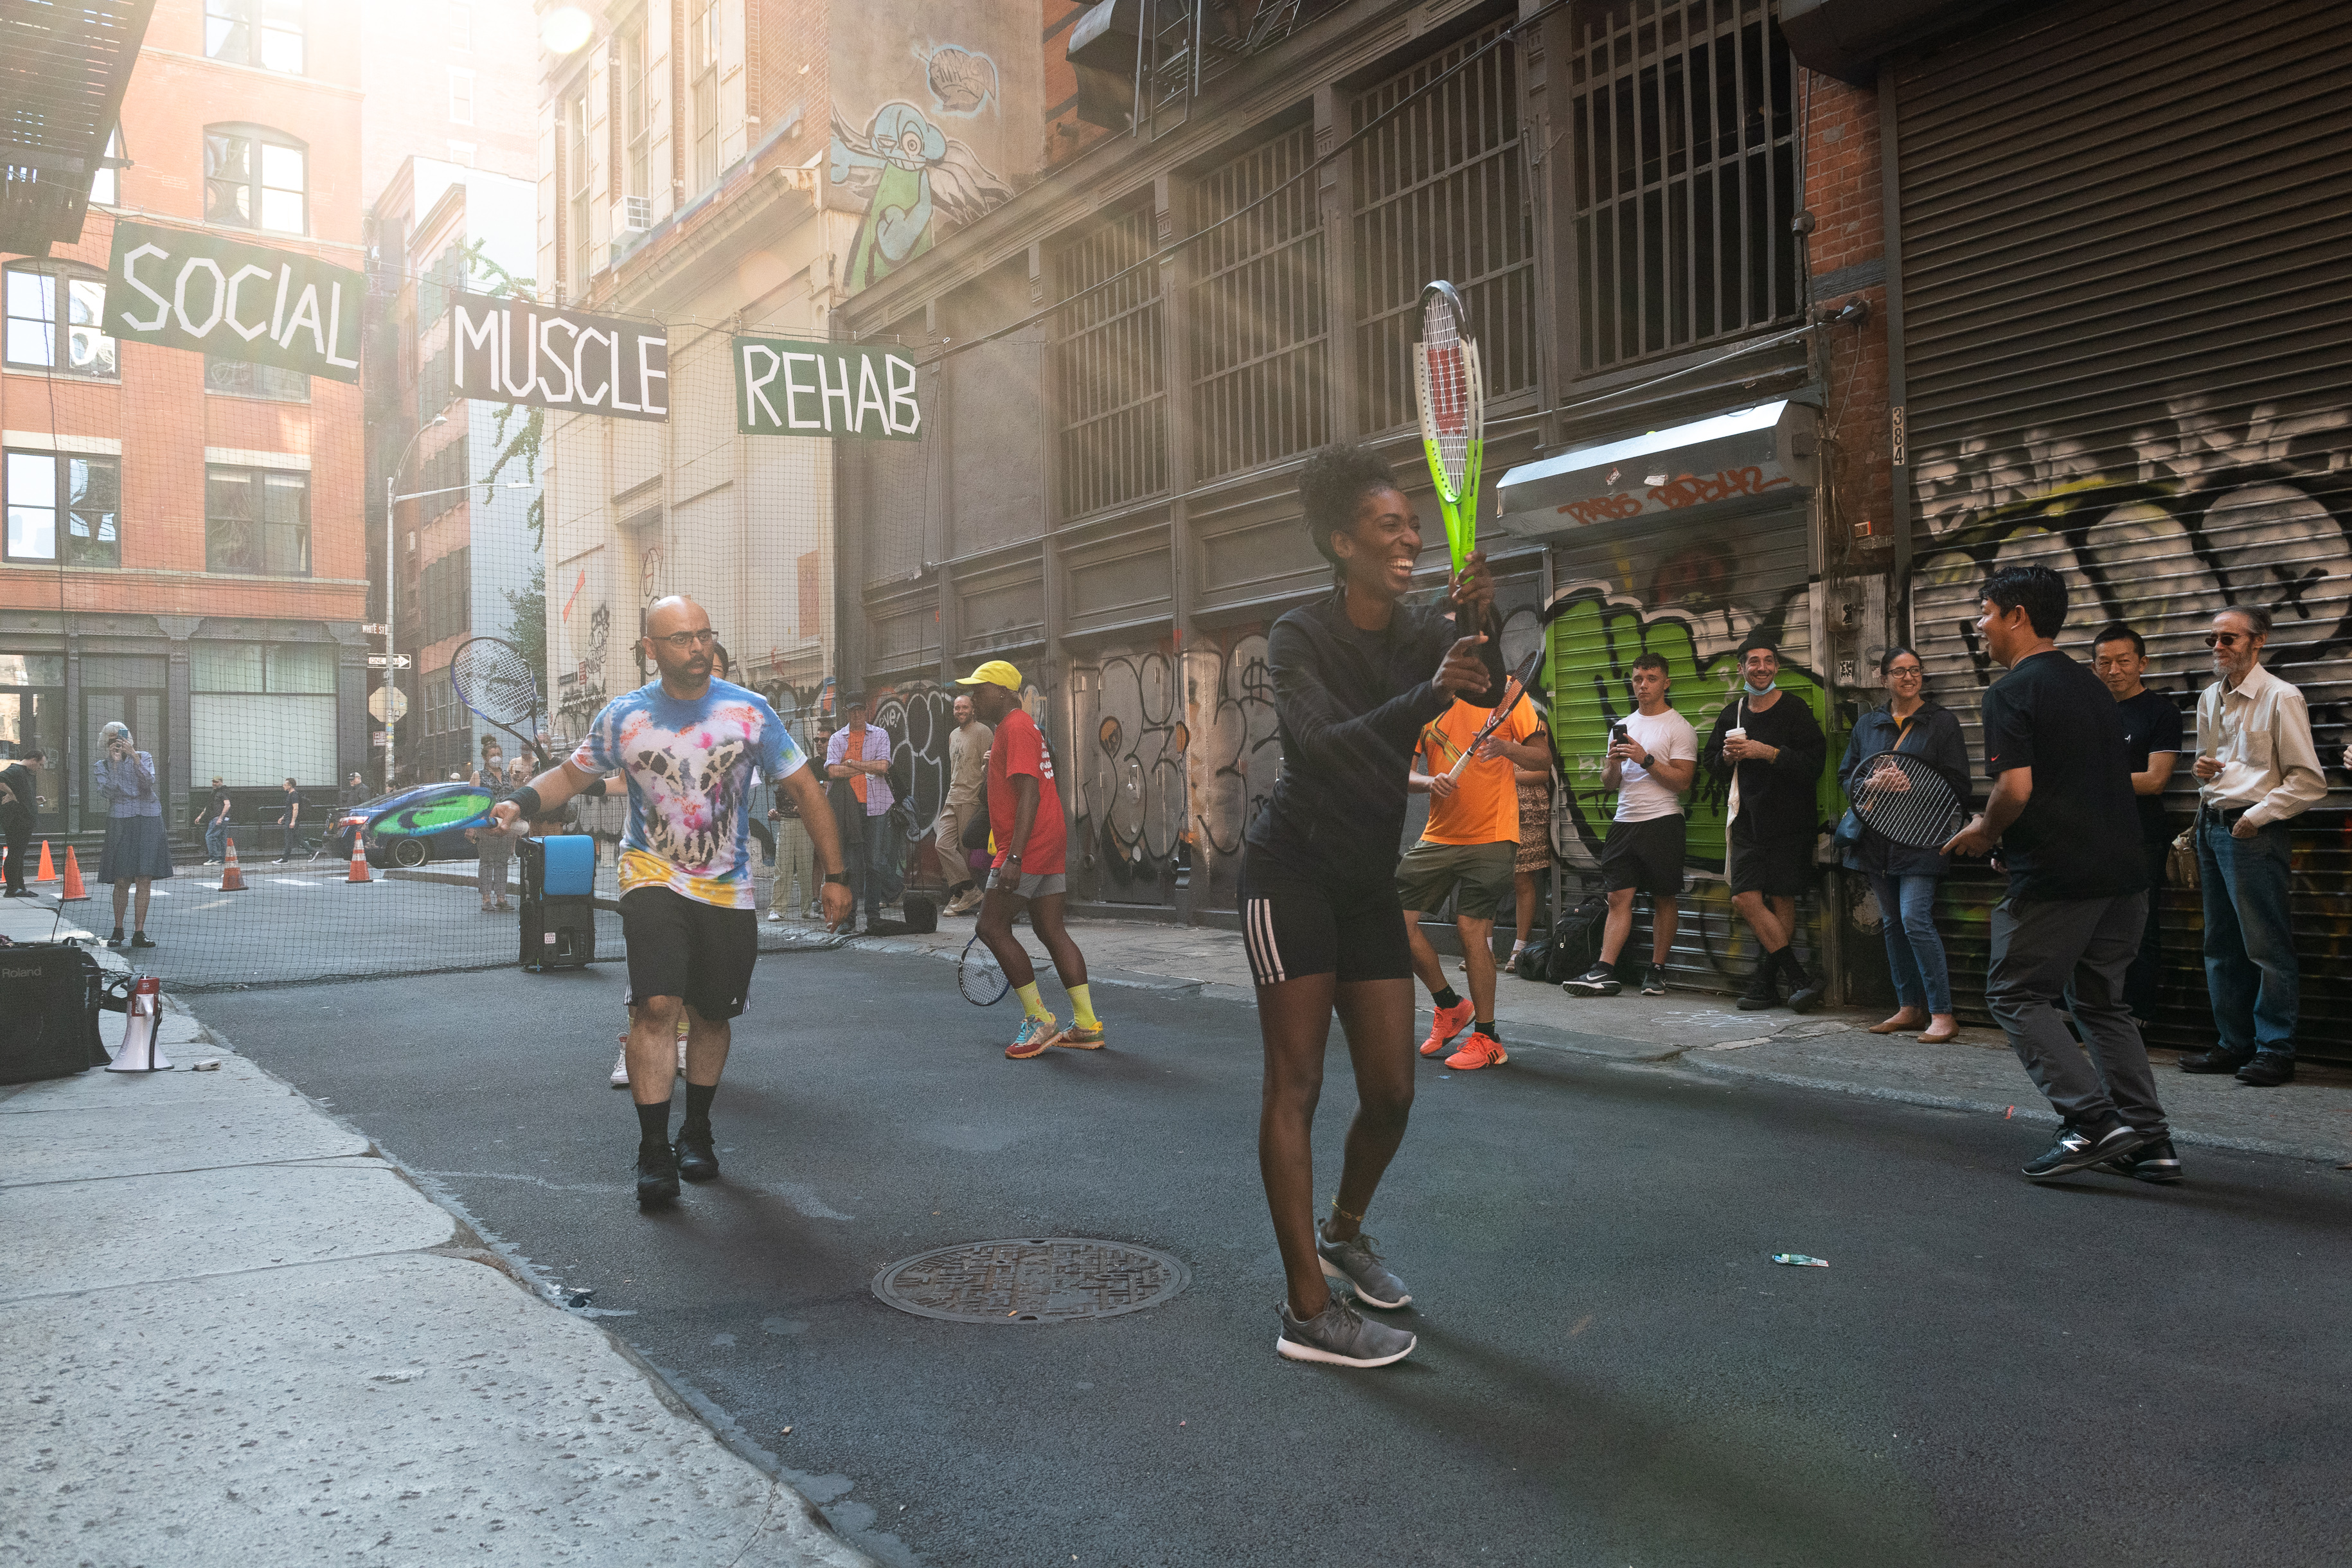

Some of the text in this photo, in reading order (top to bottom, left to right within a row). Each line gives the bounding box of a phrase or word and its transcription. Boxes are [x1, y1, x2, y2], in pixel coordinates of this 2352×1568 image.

[120, 242, 359, 369] SOCIAL
[454, 305, 668, 414] MUSCLE
[743, 344, 921, 436] REHAB
[1893, 407, 1903, 464] 384
[362, 624, 385, 634] WHITE ST
[3, 967, 41, 978] Roland
